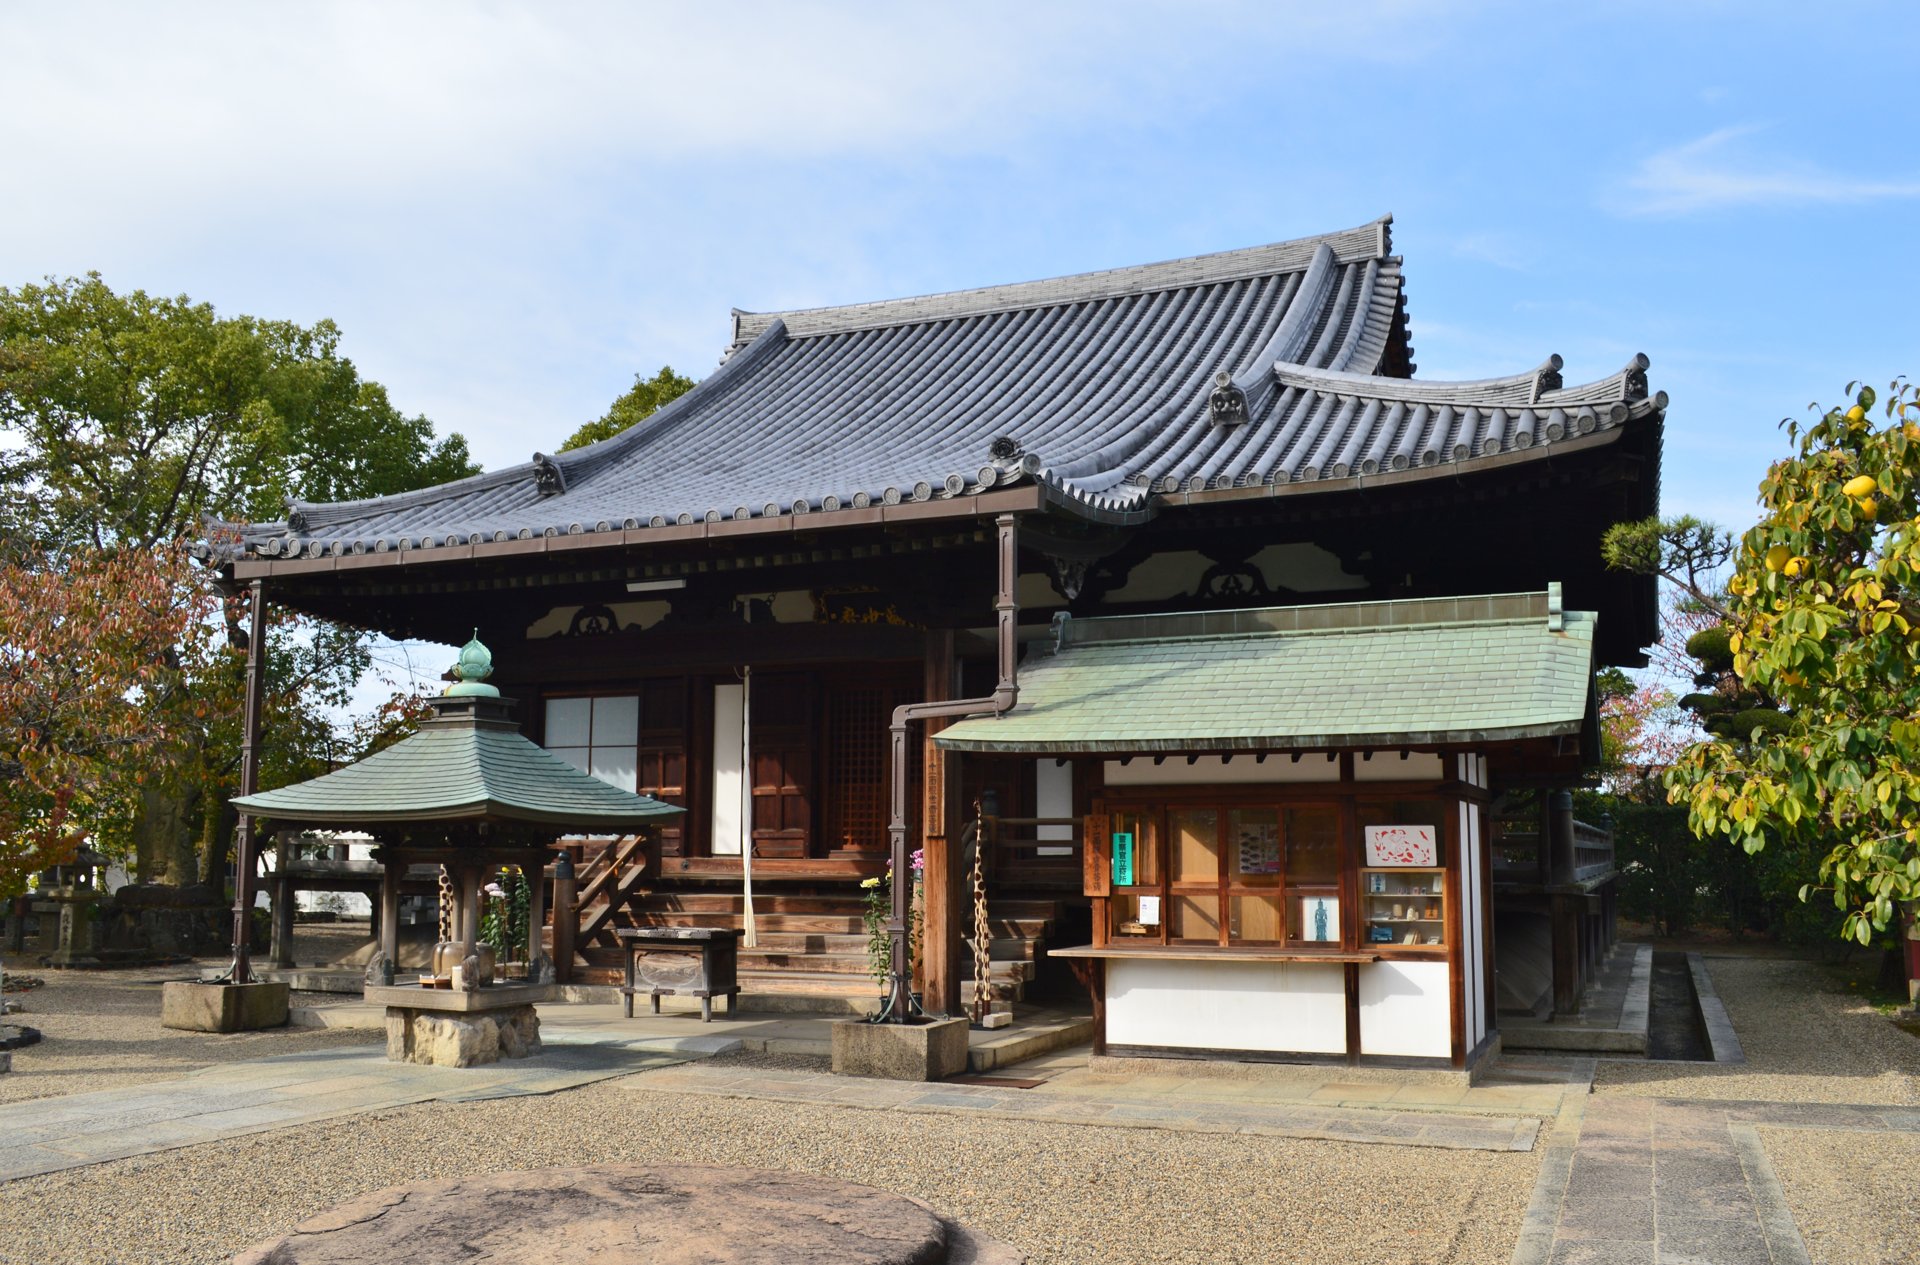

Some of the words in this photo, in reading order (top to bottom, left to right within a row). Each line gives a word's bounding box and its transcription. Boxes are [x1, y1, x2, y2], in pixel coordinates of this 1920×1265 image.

[1119, 835, 1127, 883] 警察官立寄所
